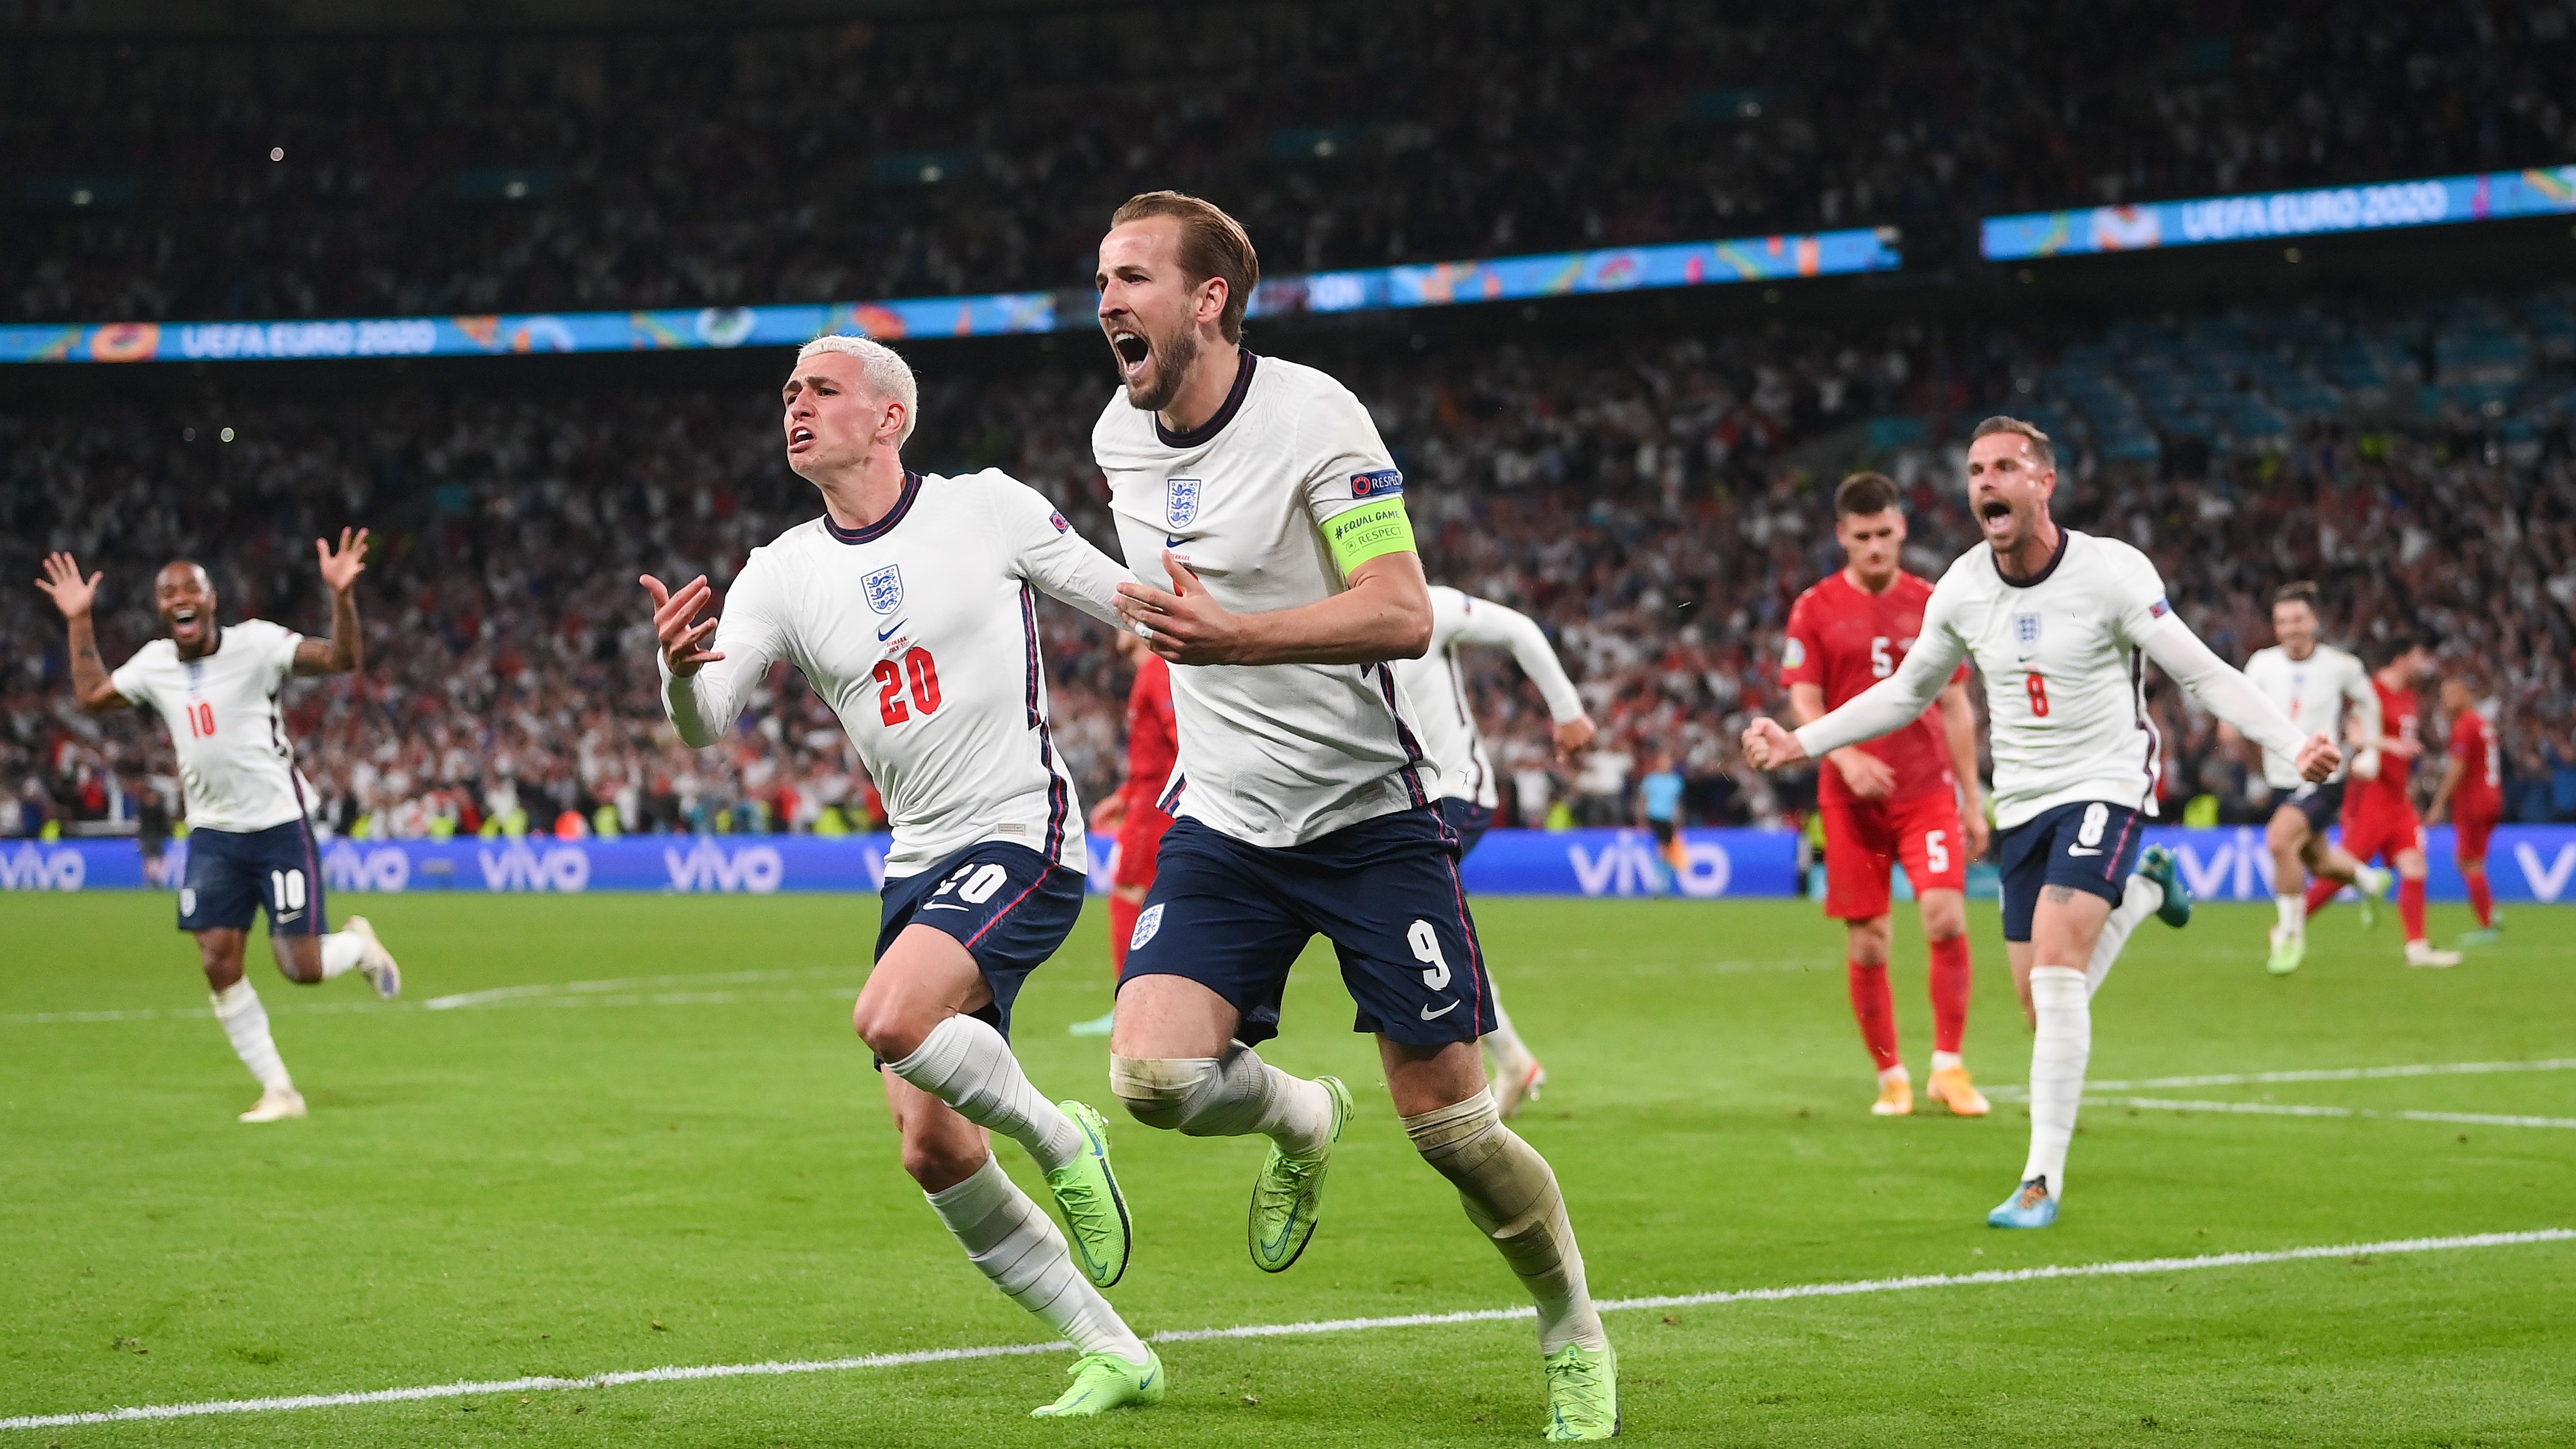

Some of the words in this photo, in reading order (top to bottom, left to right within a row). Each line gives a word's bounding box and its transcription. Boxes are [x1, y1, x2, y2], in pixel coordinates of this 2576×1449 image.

[2182, 198, 2266, 241] UEFA
[2269, 189, 2359, 234] EURO
[2361, 180, 2447, 226] 2020
[181, 323, 265, 358] UEFA
[1372, 475, 1401, 489] RESPEC
[1334, 514, 1374, 541] #EQUAL
[1375, 510, 1400, 520] GAME
[1358, 527, 1401, 544] RESPECT
[1871, 635, 1894, 678] 5
[871, 646, 942, 727] 20
[2026, 672, 2049, 717] 8
[186, 702, 215, 739] 10
[2077, 802, 2110, 847] 8
[1924, 829, 1949, 874] 5
[270, 868, 306, 911] 10
[1406, 919, 1451, 991] 9
